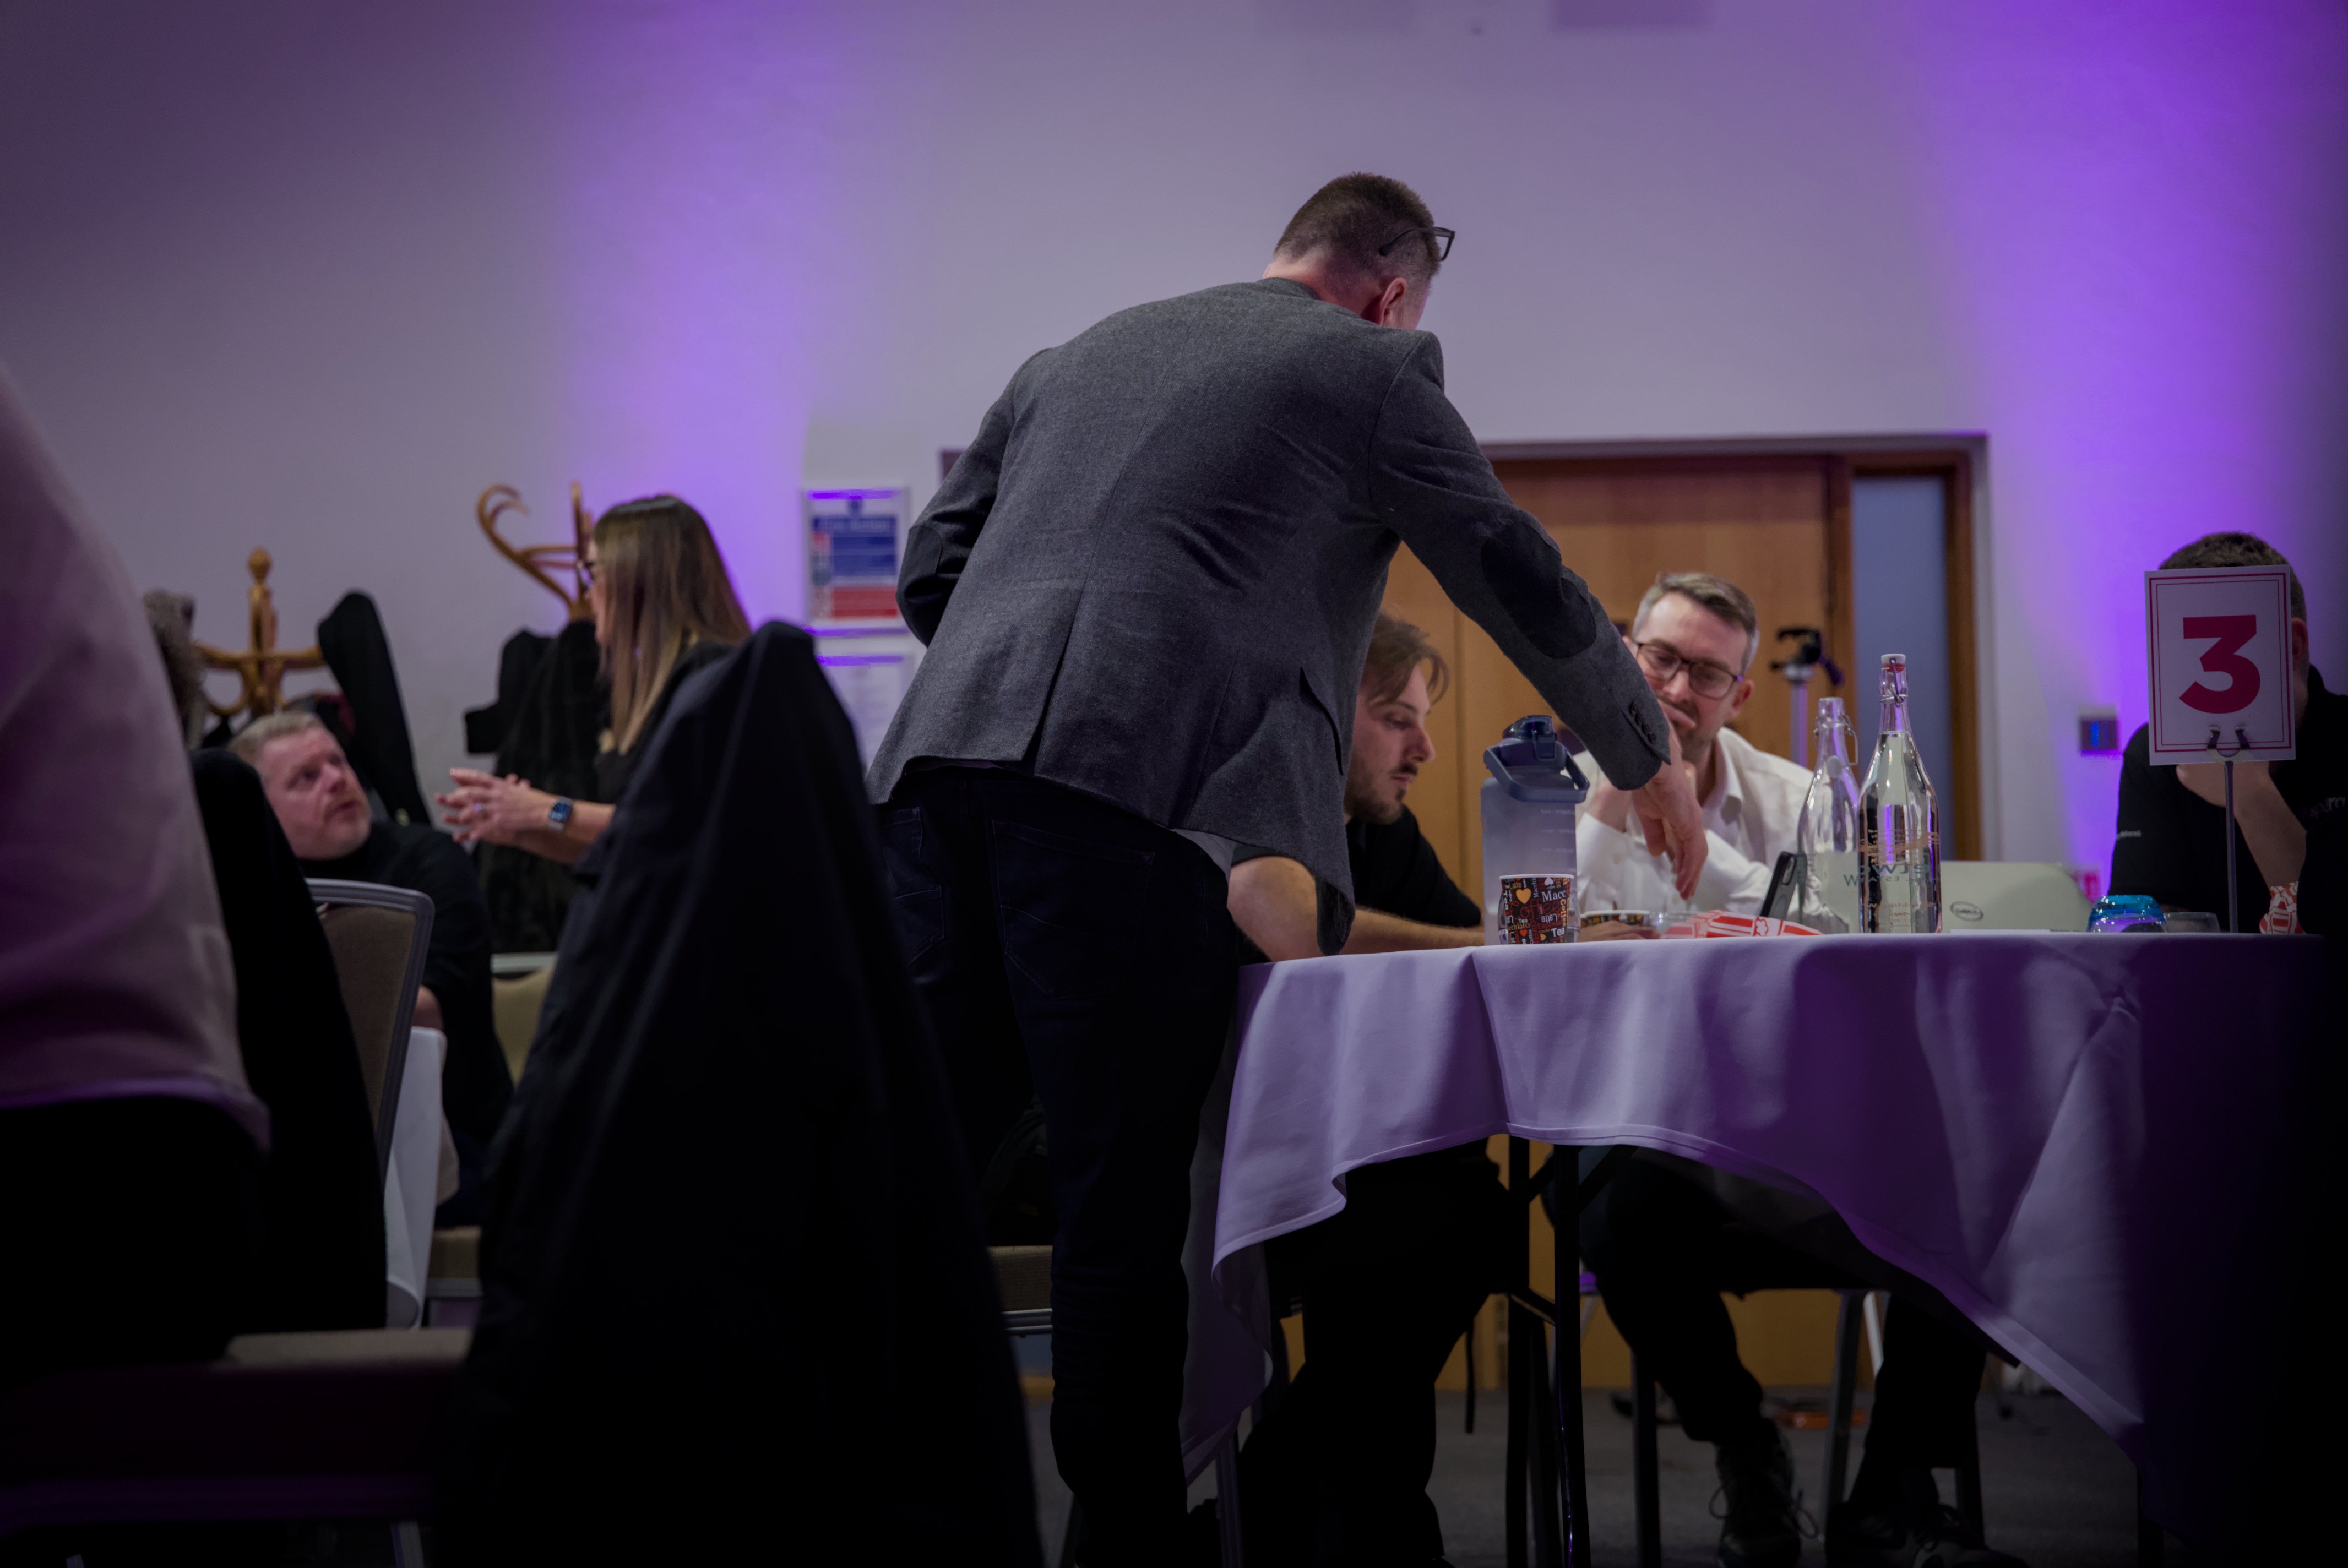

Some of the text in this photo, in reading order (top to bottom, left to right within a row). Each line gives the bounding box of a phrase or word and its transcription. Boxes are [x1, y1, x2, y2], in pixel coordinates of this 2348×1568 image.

[2179, 614, 2260, 714] 3
[1541, 890, 1567, 902] Macc
[1541, 913, 1558, 923] Latte
[1551, 927, 1565, 938] Tea
